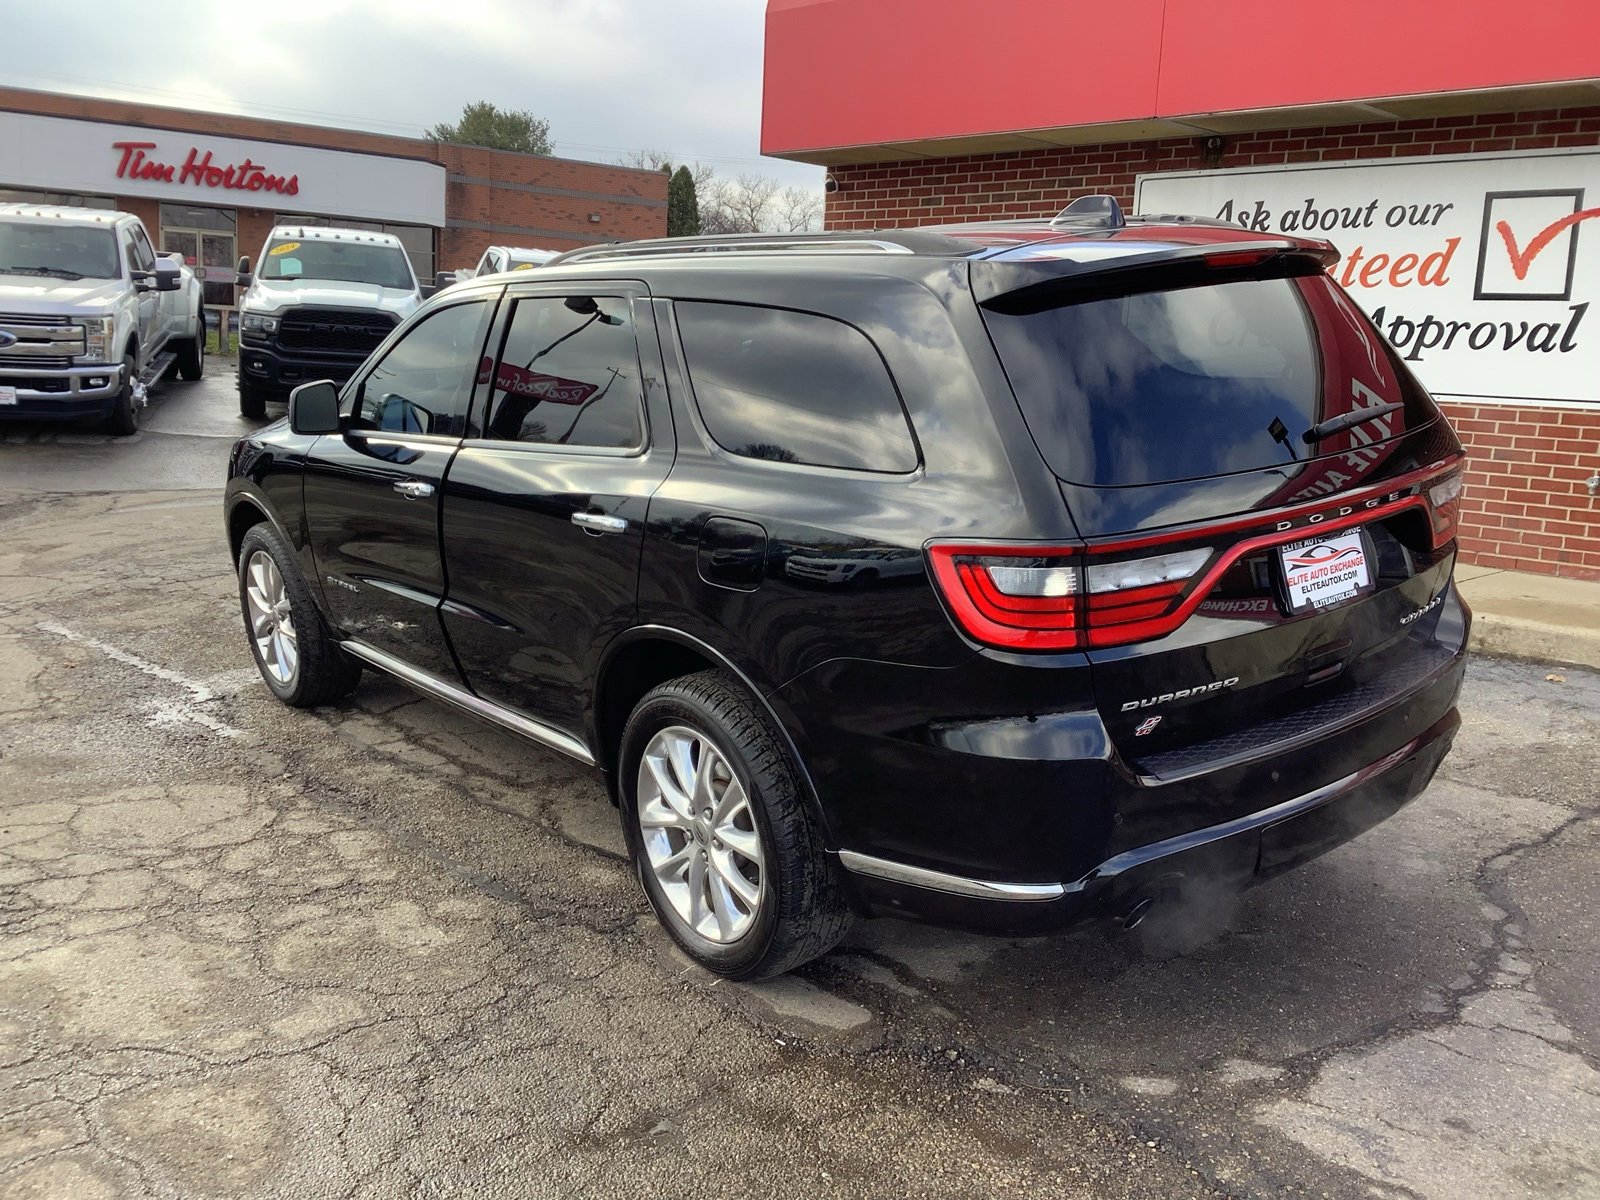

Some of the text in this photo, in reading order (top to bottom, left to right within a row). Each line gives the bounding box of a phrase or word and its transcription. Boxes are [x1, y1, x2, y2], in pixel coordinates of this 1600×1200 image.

[112, 142, 299, 196] Tim Hortons
[1215, 198, 1454, 232] Ask about our
[1327, 237, 1461, 288] teed
[1276, 491, 1400, 532] DODGE
[1287, 556, 1364, 587] ELITE AUTO EXCHANGE
[1301, 570, 1358, 594] ELITEAUTOX.COM
[1120, 676, 1240, 712] DURANGO
